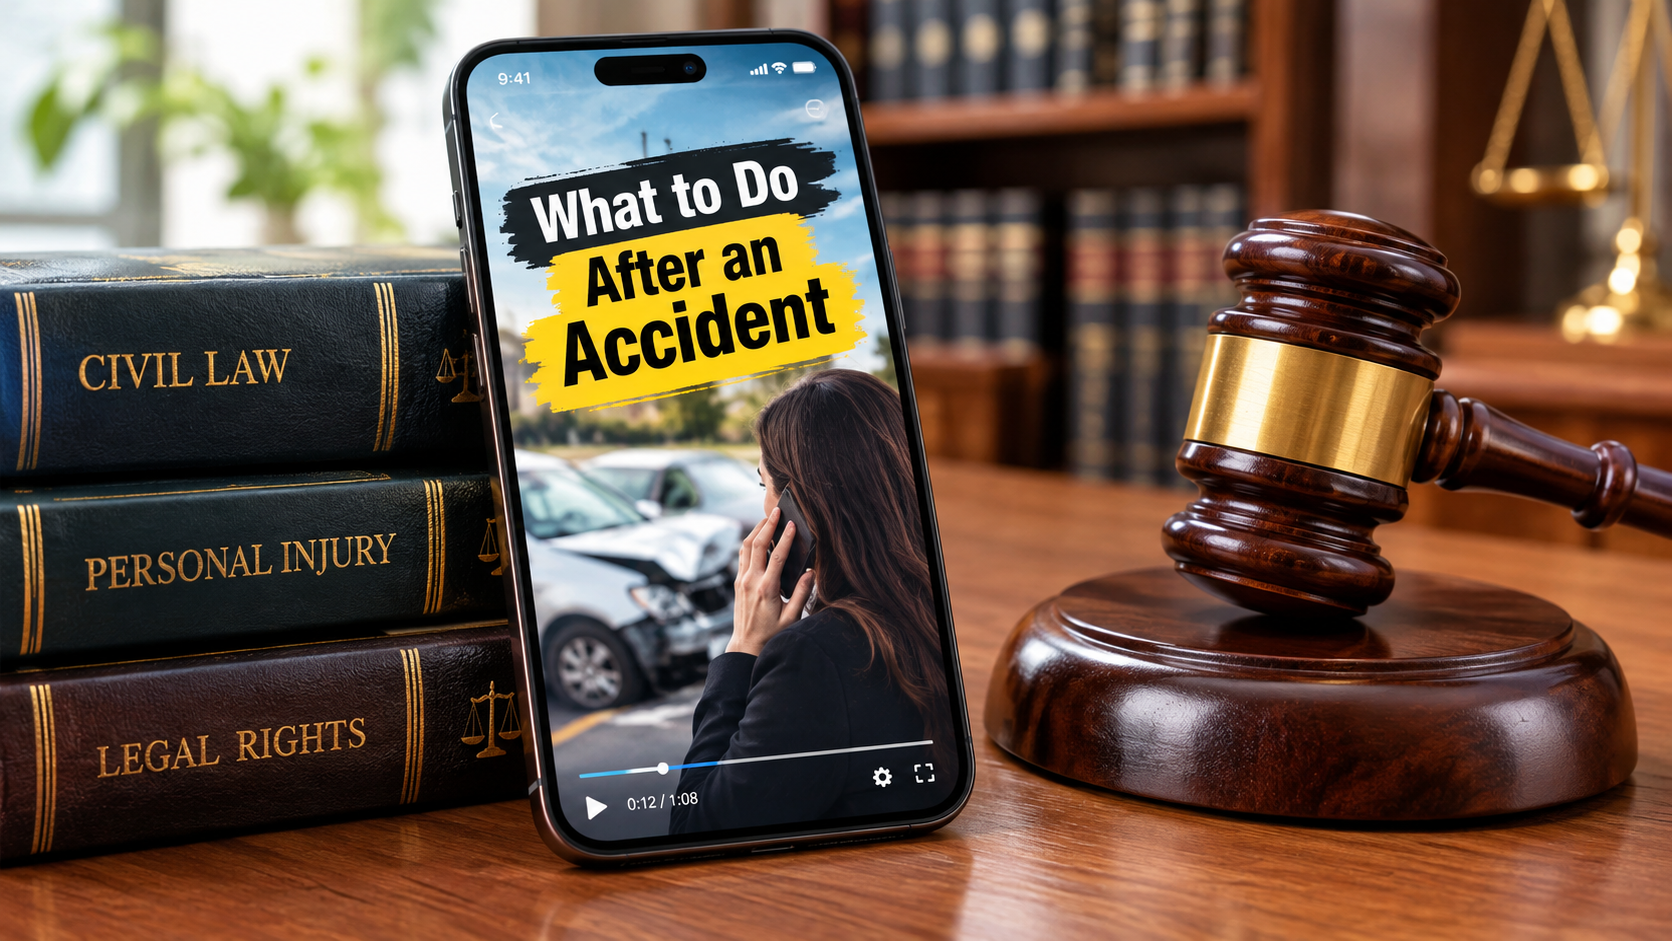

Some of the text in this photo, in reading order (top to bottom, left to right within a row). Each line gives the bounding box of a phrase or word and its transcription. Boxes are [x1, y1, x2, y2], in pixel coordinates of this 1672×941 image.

[497, 71, 531, 86] 9:41
[530, 160, 799, 244] What to Do
[586, 235, 783, 307] After an
[563, 277, 836, 388] Accident
[78, 348, 292, 392] CIVIL LAW
[84, 532, 397, 592] PERSONAL INJURY
[96, 717, 367, 779] LEGAL RIGHTS
[627, 791, 699, 811] 0:12 / 1:08
